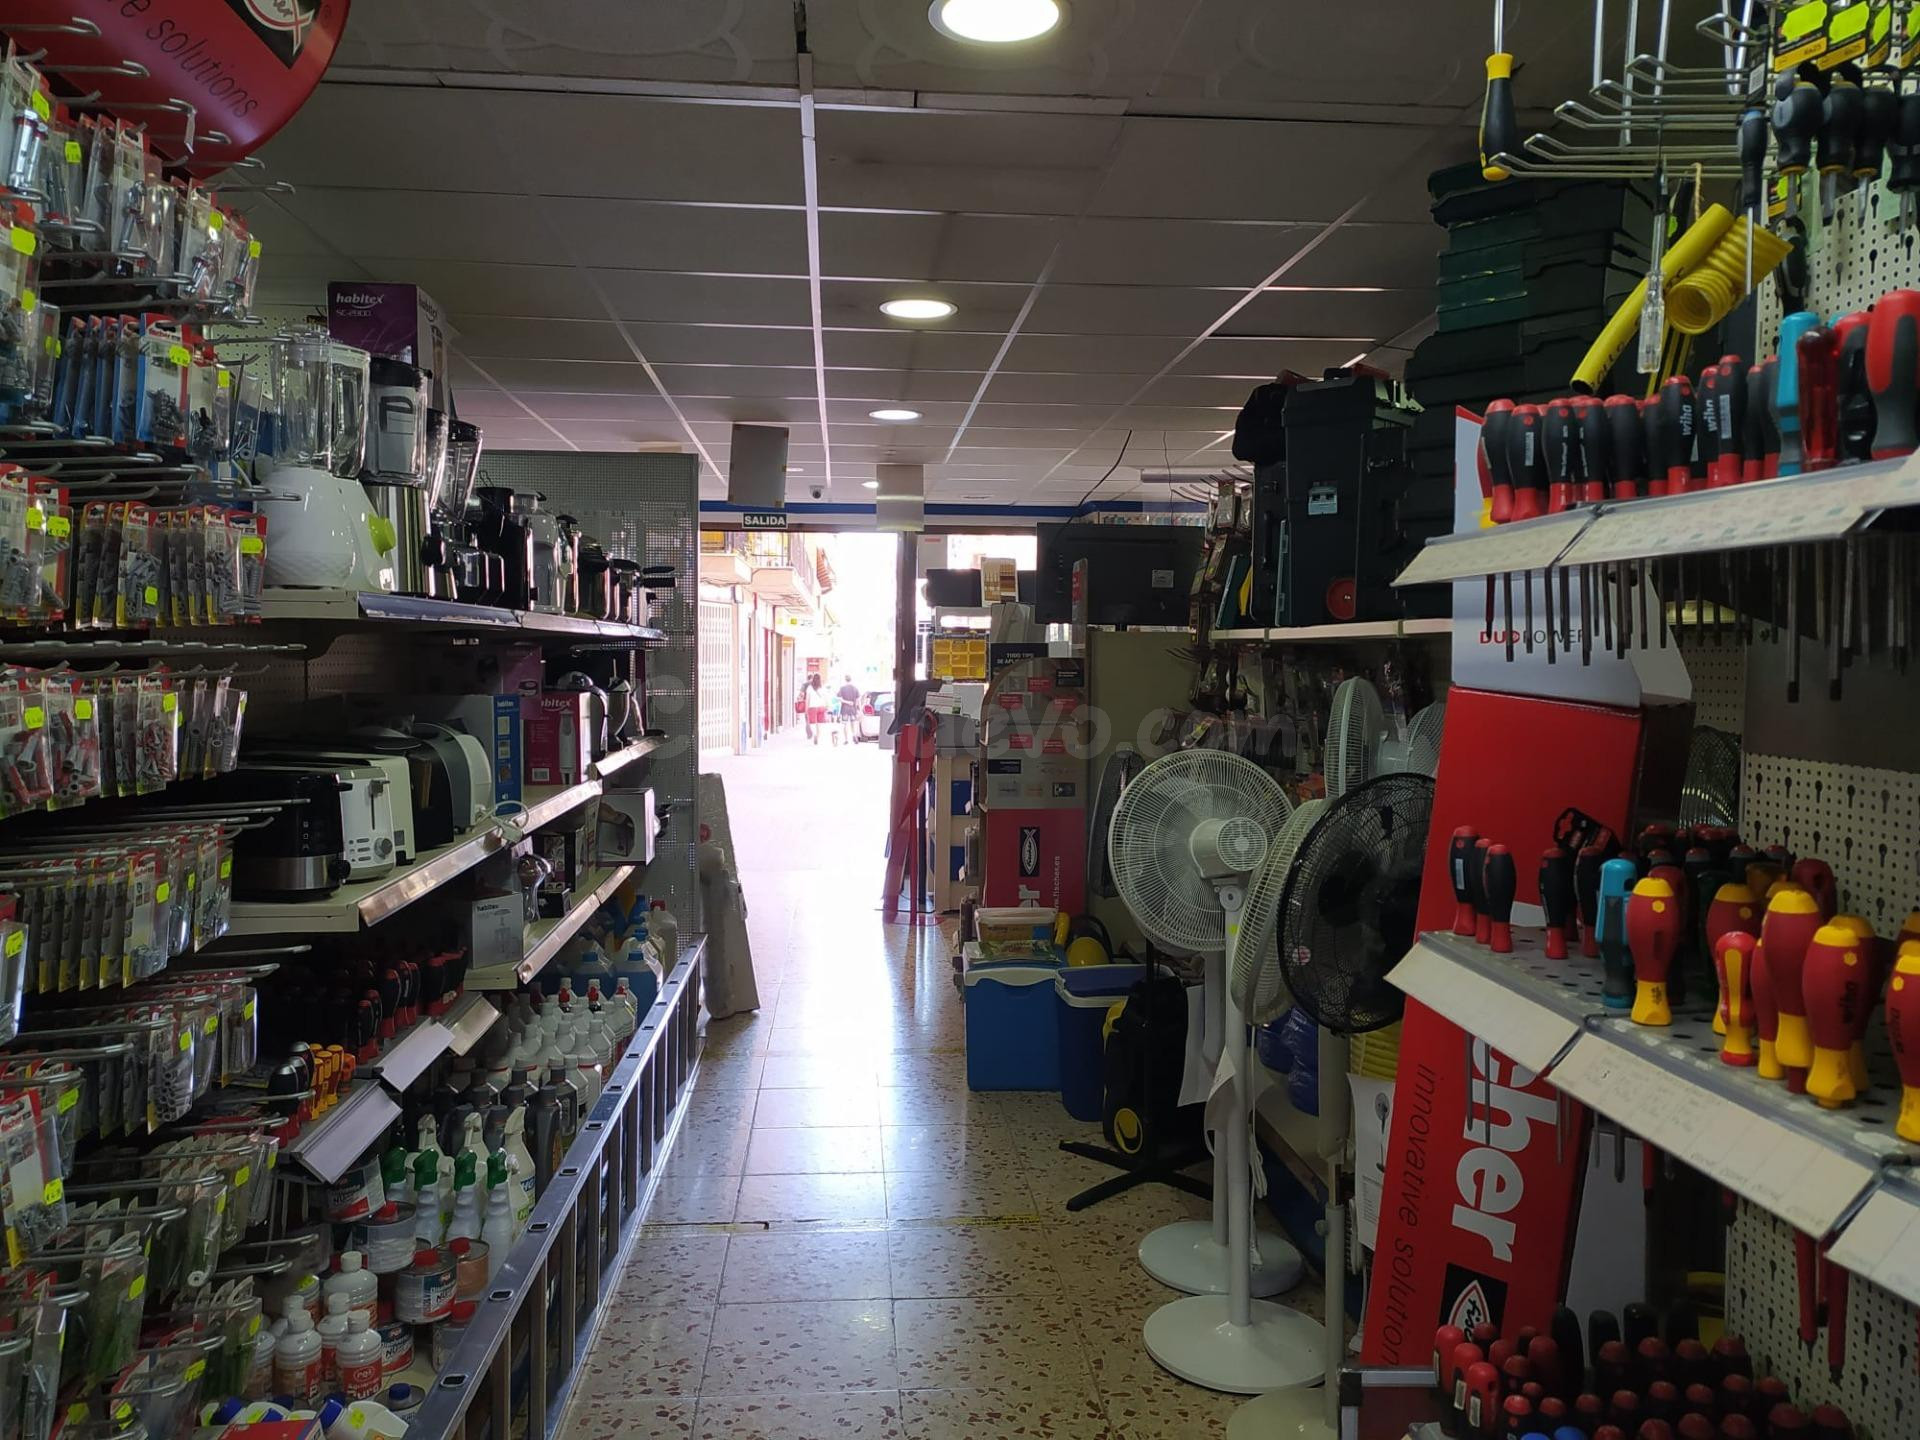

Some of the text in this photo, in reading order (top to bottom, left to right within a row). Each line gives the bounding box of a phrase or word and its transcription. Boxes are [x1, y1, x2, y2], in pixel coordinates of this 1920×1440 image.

[146, 19, 259, 119] solutions
[336, 292, 385, 304] habitex
[744, 515, 786, 526] SALIDA
[541, 697, 572, 707] bitex
[1452, 1038, 1559, 1263] cher
[1380, 1063, 1436, 1365] innovative solution
[1462, 1298, 1485, 1344] fisc
